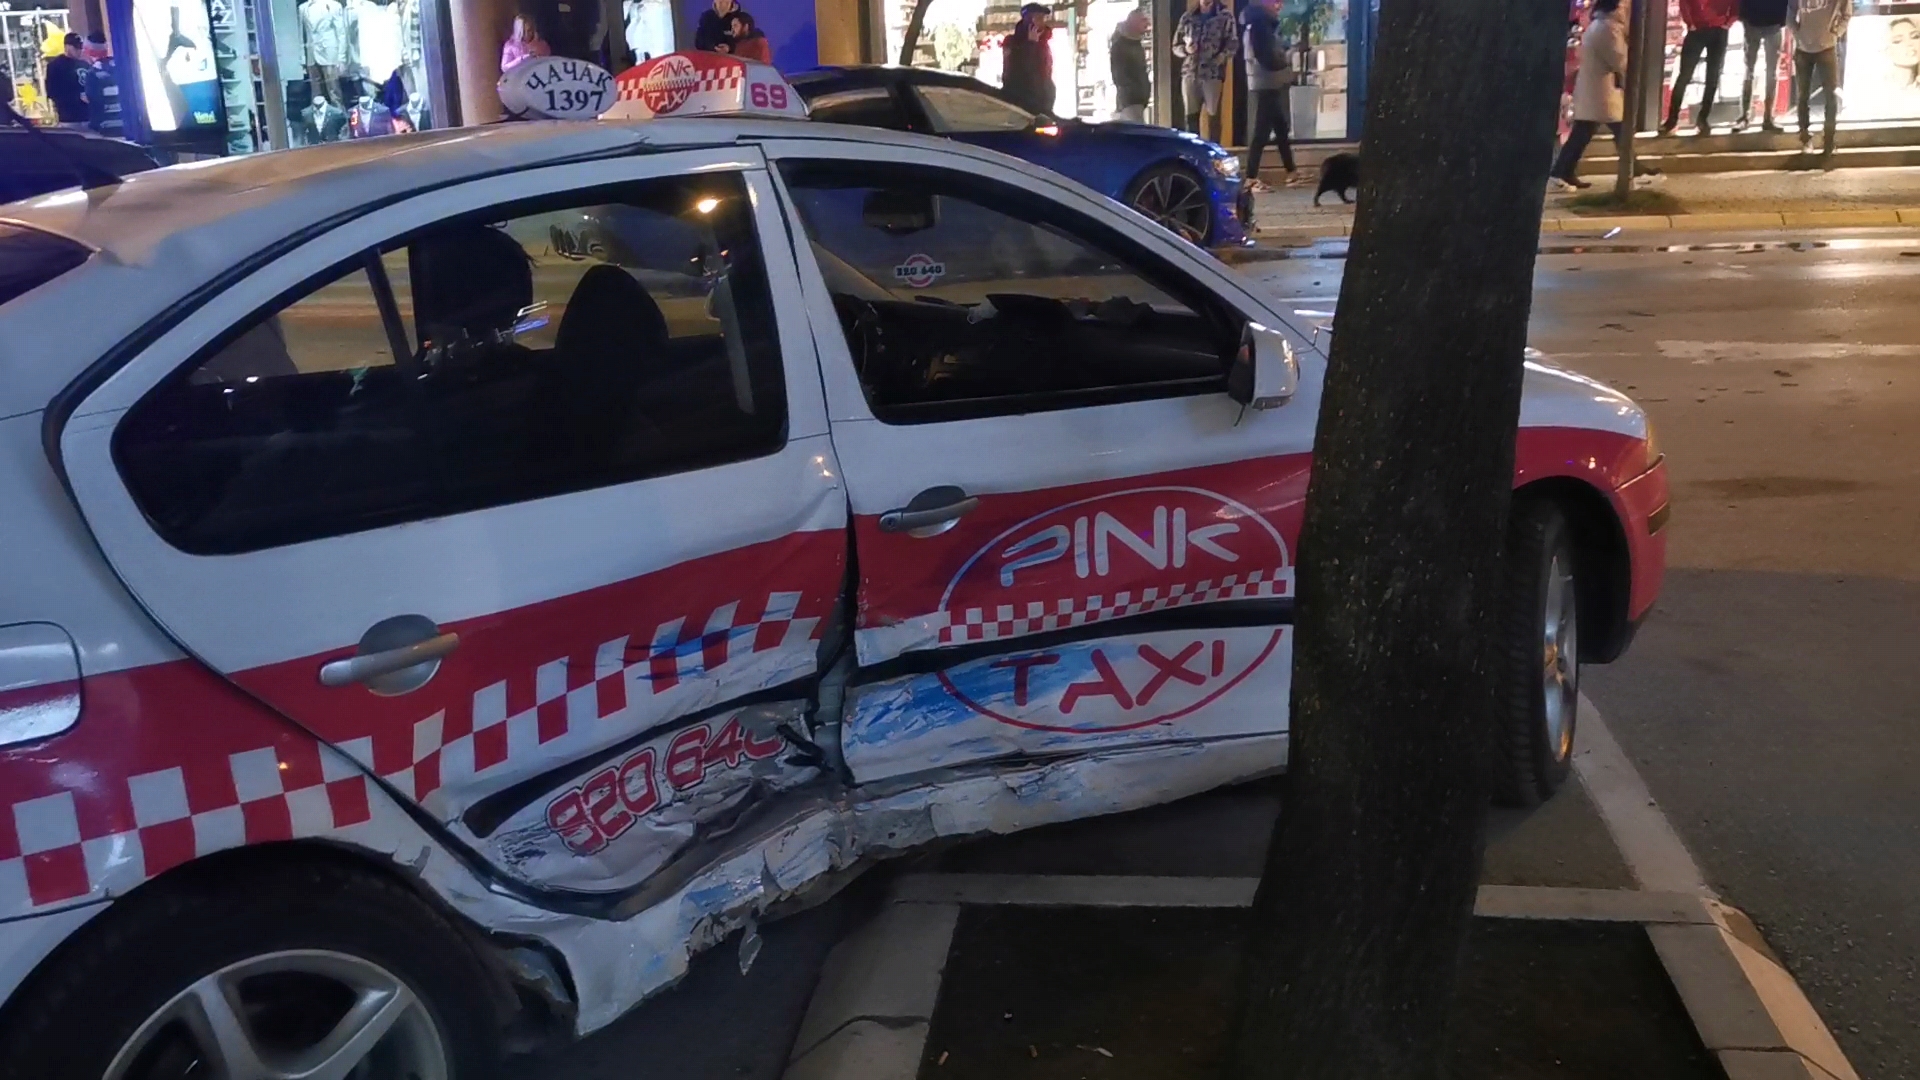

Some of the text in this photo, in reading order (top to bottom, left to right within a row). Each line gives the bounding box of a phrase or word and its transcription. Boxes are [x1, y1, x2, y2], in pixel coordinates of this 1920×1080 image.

[525, 61, 612, 92] ЧАЧАК
[651, 60, 692, 79] PINK
[545, 89, 604, 111] 1397
[649, 89, 688, 111] TAXI
[750, 82, 788, 109] 69
[1000, 505, 1241, 587] PINK
[990, 640, 1226, 714] TAXI
[547, 747, 660, 856] 920
